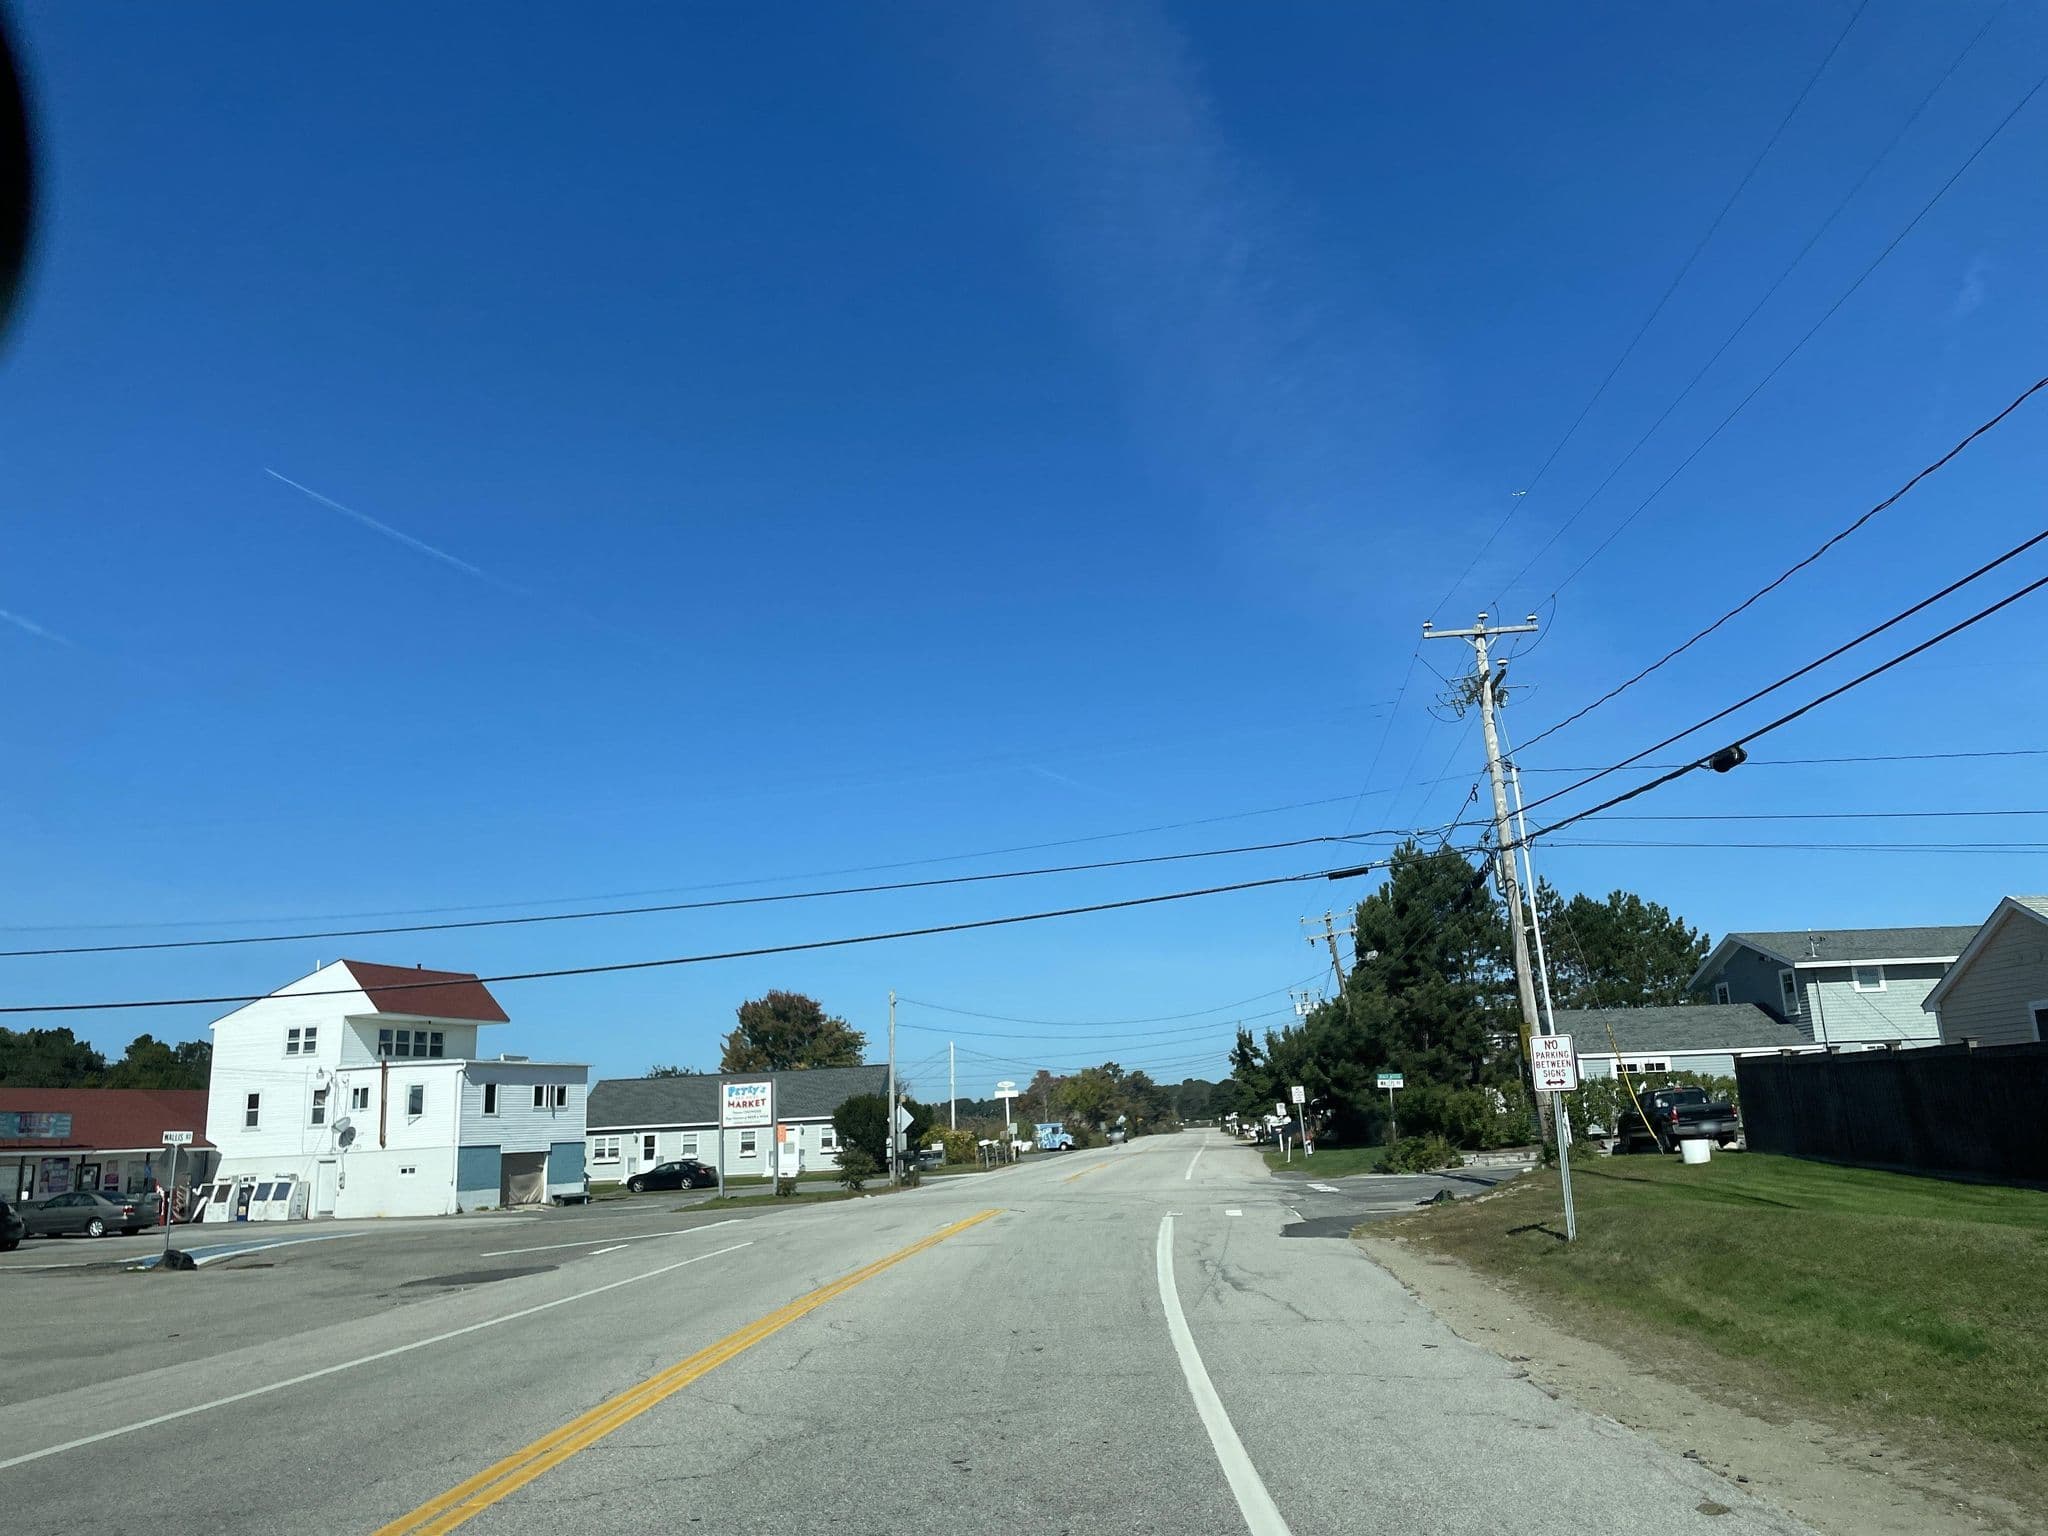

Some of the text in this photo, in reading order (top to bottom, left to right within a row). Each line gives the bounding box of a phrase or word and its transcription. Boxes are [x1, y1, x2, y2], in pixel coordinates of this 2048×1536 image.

[1544, 1040, 1558, 1050] NO
[1536, 1050, 1569, 1060] PARKING
[1536, 1059, 1572, 1069] BETWEEN
[1543, 1068, 1567, 1078] SIGNS
[728, 1098, 767, 1108] MARKET
[164, 1132, 184, 1142] WALLIS
